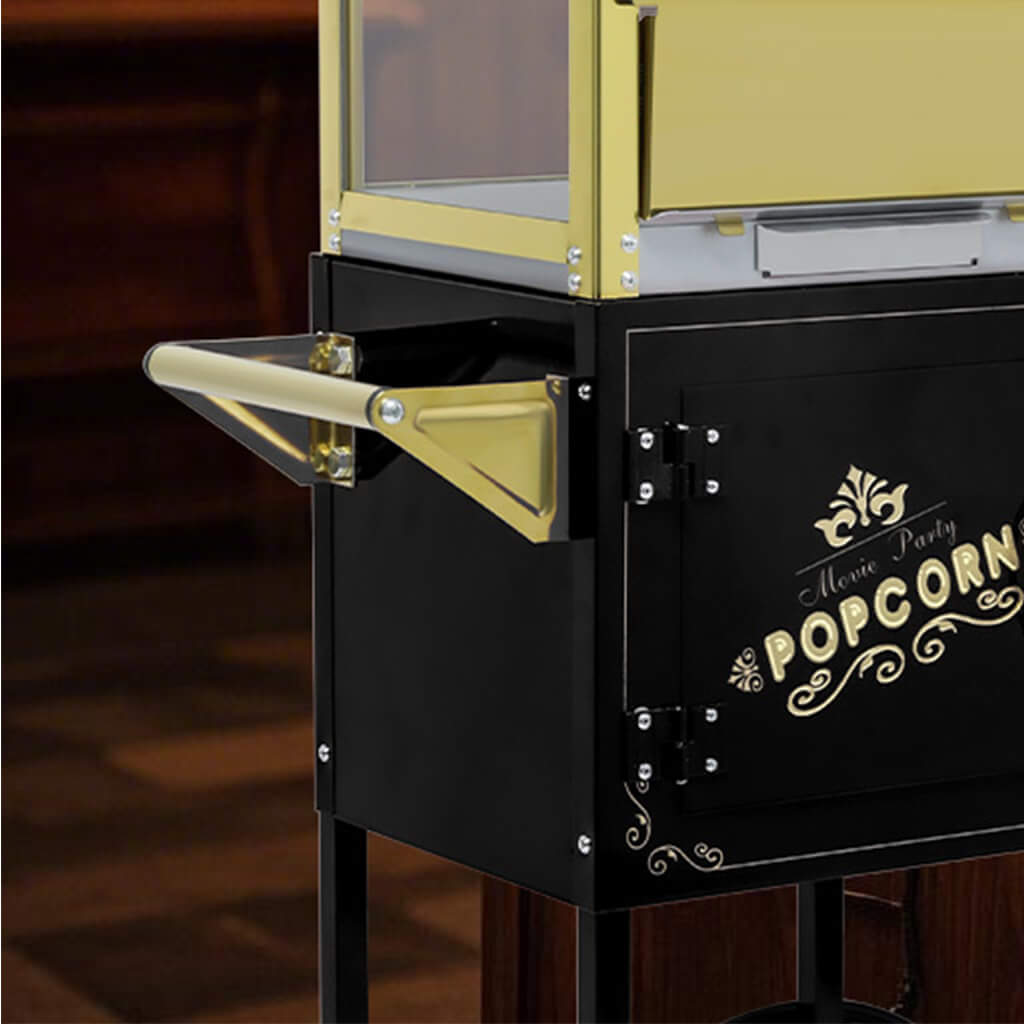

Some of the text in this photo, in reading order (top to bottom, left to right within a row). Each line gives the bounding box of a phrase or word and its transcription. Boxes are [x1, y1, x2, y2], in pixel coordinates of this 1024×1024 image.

[763, 524, 1020, 683] POPCORN
[798, 519, 959, 608] Movie Party
